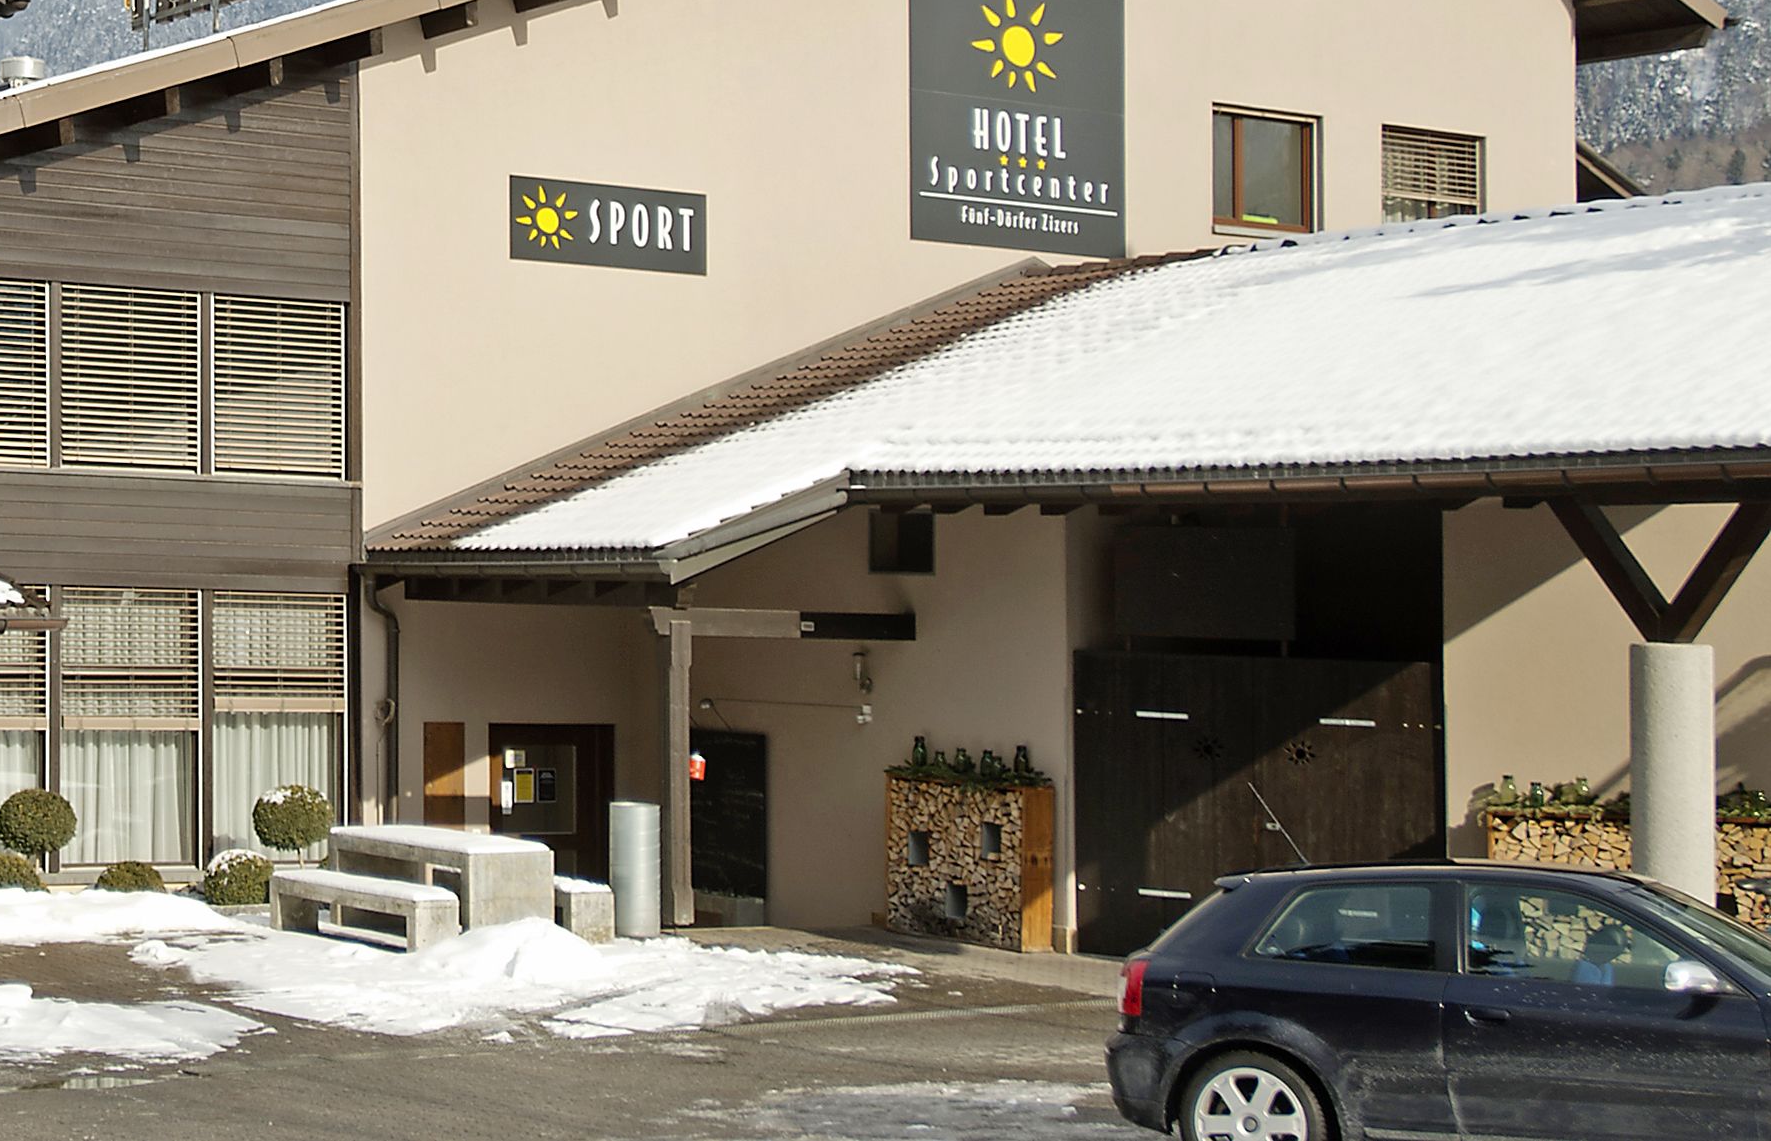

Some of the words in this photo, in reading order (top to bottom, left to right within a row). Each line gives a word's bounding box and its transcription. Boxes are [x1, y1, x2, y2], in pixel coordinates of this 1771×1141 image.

[973, 108, 1067, 159] HOTEL
[930, 156, 1109, 204] Sportcenter
[588, 198, 694, 252] SPORT
[961, 205, 1037, 230] Fünf-Dörfer
[1041, 213, 1079, 235] Zizers
